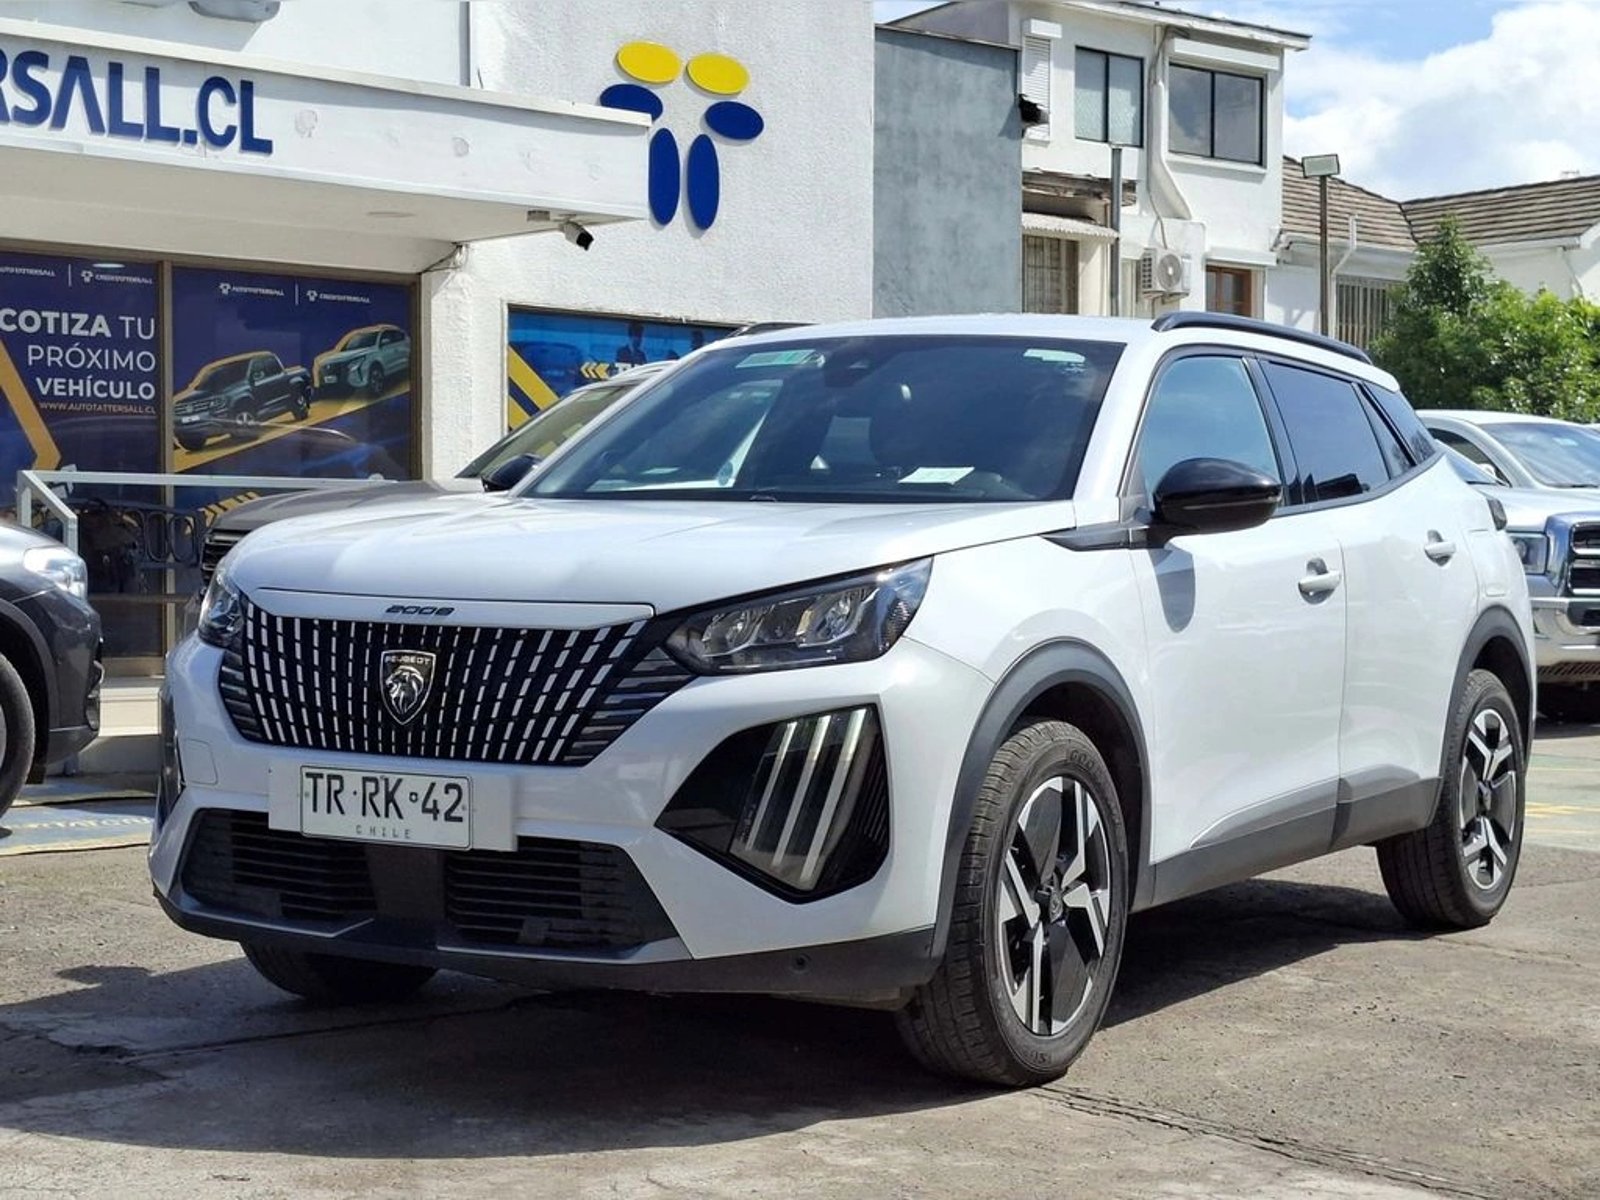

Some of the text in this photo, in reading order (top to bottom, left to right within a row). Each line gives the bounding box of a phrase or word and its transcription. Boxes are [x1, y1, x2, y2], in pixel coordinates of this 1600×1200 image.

[0, 48, 273, 154] SALL.CL
[0, 308, 156, 340] COTIZA TU
[27, 341, 156, 372] PRÓXIMO
[35, 375, 156, 400] VEHÍCULO
[385, 605, 455, 616] 2008
[384, 655, 431, 665] PEUGEOT
[355, 824, 412, 839] CHILE
